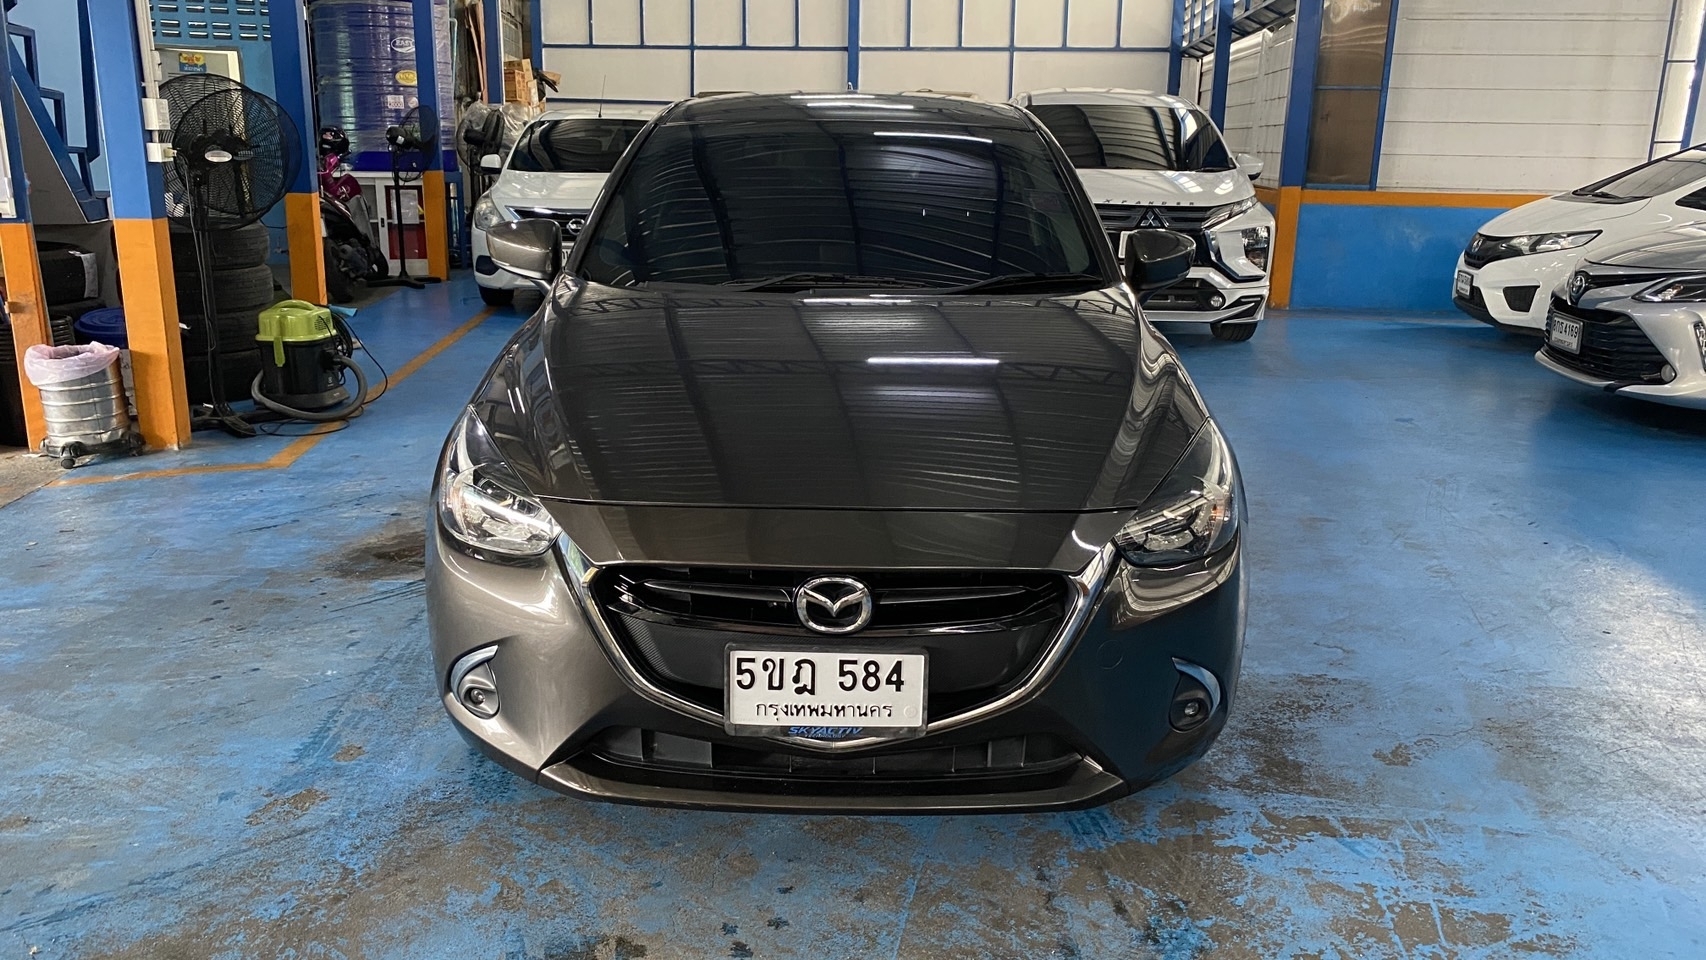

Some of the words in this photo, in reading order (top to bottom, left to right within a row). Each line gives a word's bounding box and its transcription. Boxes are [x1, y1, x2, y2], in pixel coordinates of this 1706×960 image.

[736, 657, 816, 695] 5ขฎ
[838, 659, 905, 692] 584
[756, 703, 893, 721] กรุงเทพมหานคร
[788, 726, 863, 734] SKYACTIV
